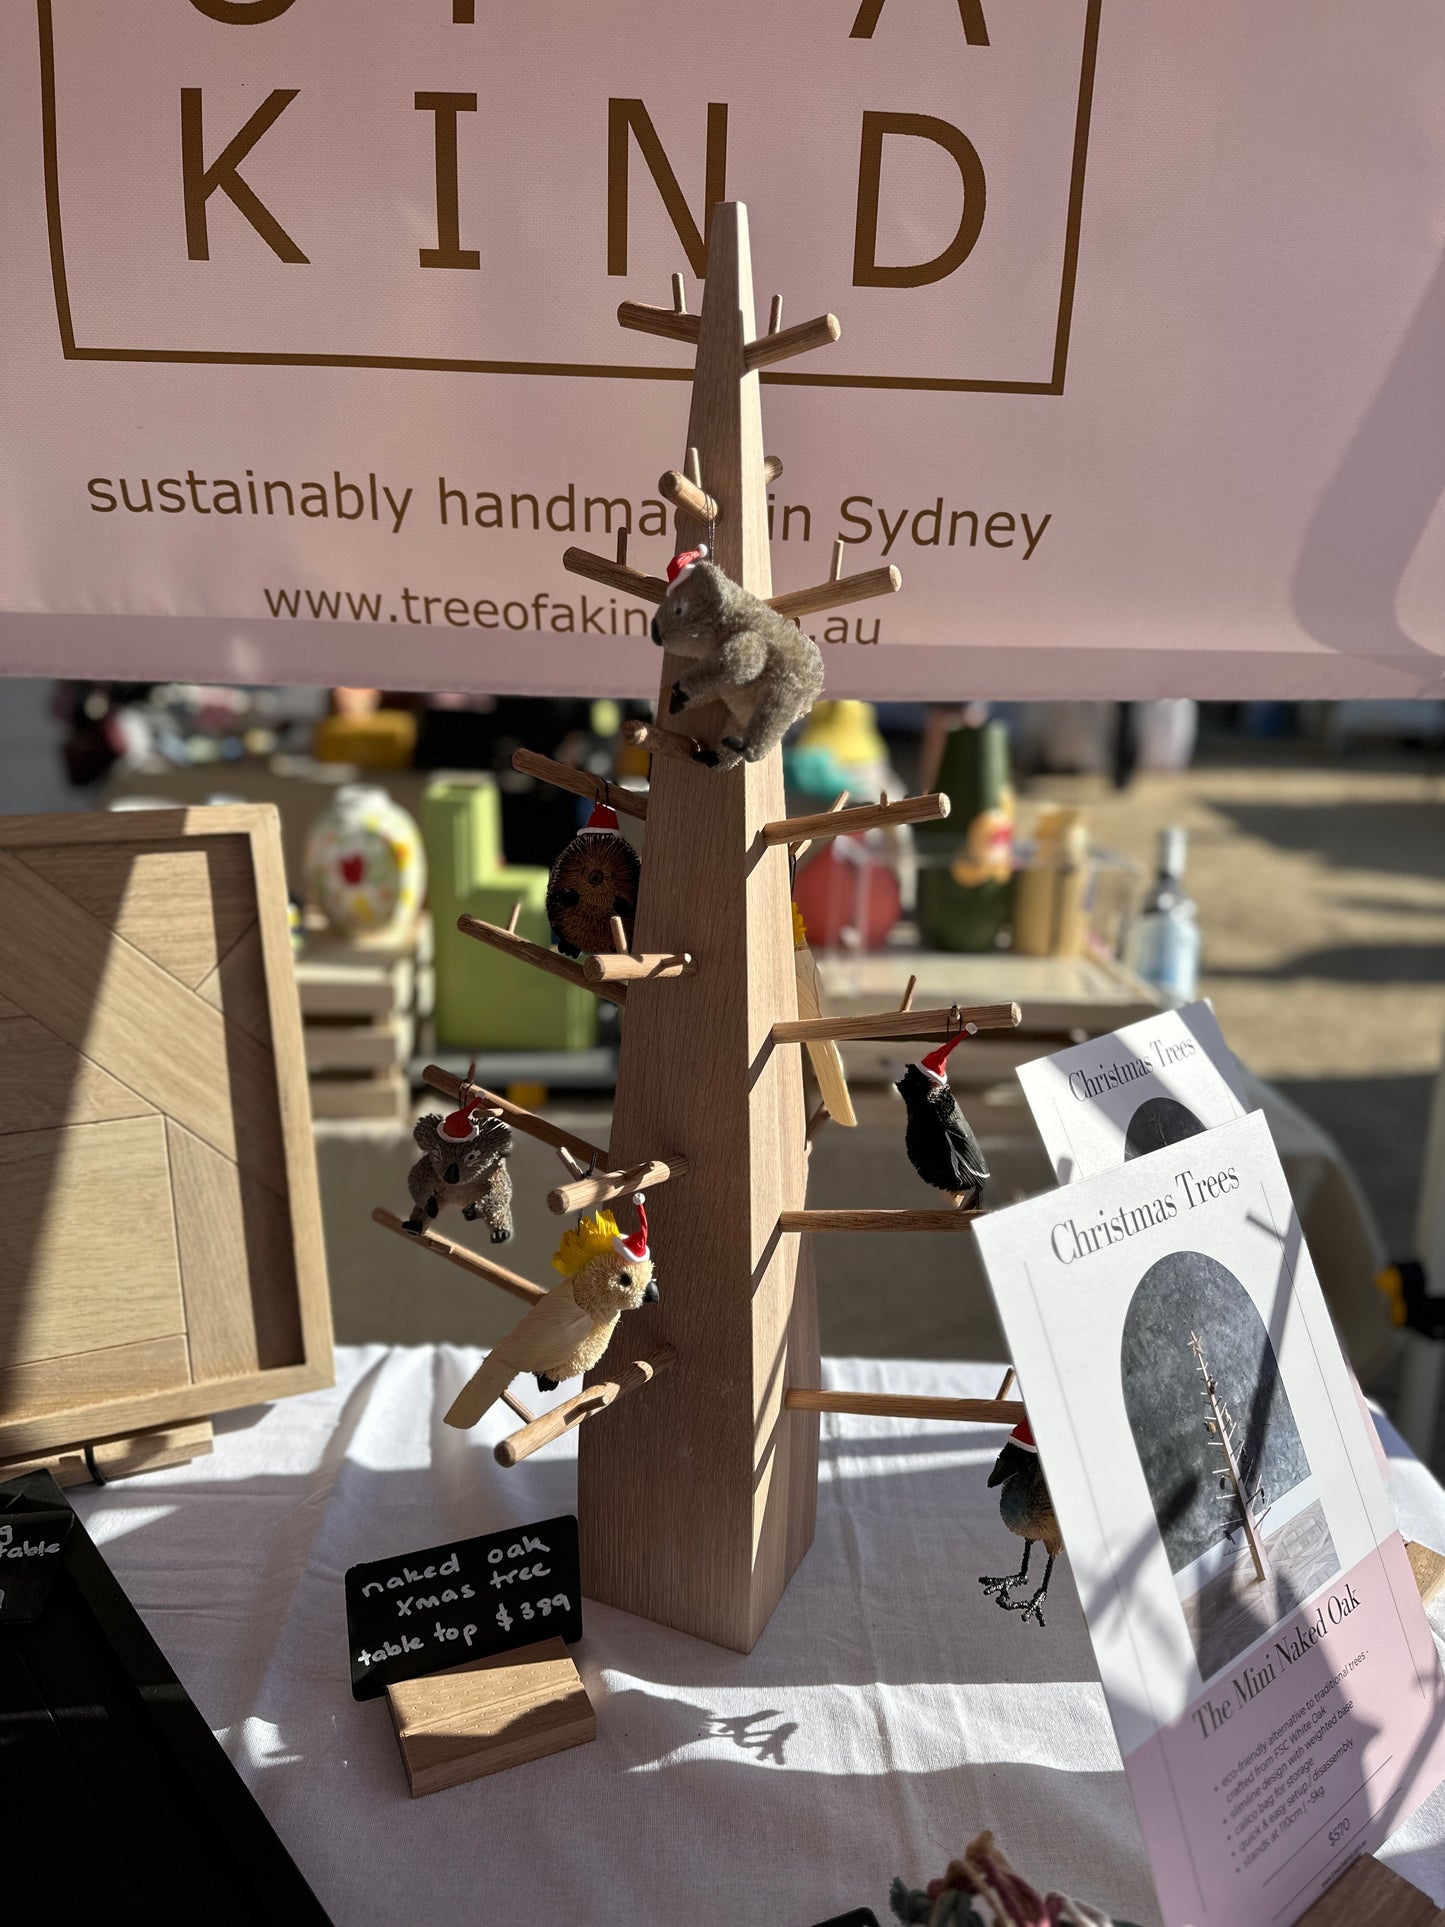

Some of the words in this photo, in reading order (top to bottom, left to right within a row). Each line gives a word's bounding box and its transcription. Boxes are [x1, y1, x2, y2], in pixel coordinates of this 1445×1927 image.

[181, 88, 987, 289] KIND
[87, 470, 412, 533] sustainably
[440, 477, 678, 536] handma
[768, 493, 811, 542] in
[838, 495, 1052, 561] Sydney
[1068, 1056, 1153, 1102] Christmas
[1149, 1039, 1196, 1067] Trees
[1051, 1194, 1177, 1265] Christmas
[1175, 1167, 1240, 1209] Trees
[361, 1553, 460, 1597] naked
[487, 1536, 550, 1563] oak
[490, 1562, 551, 1589] tree
[358, 1635, 424, 1666] table
[434, 1621, 477, 1647] top
[1192, 1700, 1233, 1740] The
[1232, 1654, 1276, 1710] Mini
[1274, 1608, 1328, 1672] Naked
[1327, 1584, 1361, 1625] Oak
[1222, 1741, 1268, 1787] eco-friendly
[1268, 1706, 1305, 1746] alternative
[1306, 1698, 1314, 1711] to
[1314, 1666, 1349, 1703] traditional
[1348, 1652, 1365, 1670] trees
[1226, 1772, 1255, 1803] crafted
[1254, 1755, 1273, 1776] from
[1273, 1739, 1289, 1759] FSC
[1288, 1720, 1312, 1744] White
[1312, 1706, 1327, 1723] Oak
[1230, 1787, 1261, 1819] slimline
[1261, 1762, 1288, 1791] design
[1286, 1746, 1304, 1766] with
[1304, 1714, 1338, 1749] weighted
[1337, 1700, 1354, 1719] base
[1235, 1809, 1258, 1835] calico
[1258, 1794, 1274, 1814] bag
[1274, 1782, 1286, 1798] for
[1286, 1757, 1314, 1787] storage
[1239, 1826, 1262, 1851] quick
[1268, 1802, 1286, 1823] easy
[1286, 1782, 1308, 1807] setup
[1312, 1737, 1354, 1782] disassembly
[1328, 1817, 1350, 1847] $570
[1243, 1839, 1270, 1867] stands
[1270, 1829, 1279, 1842] at
